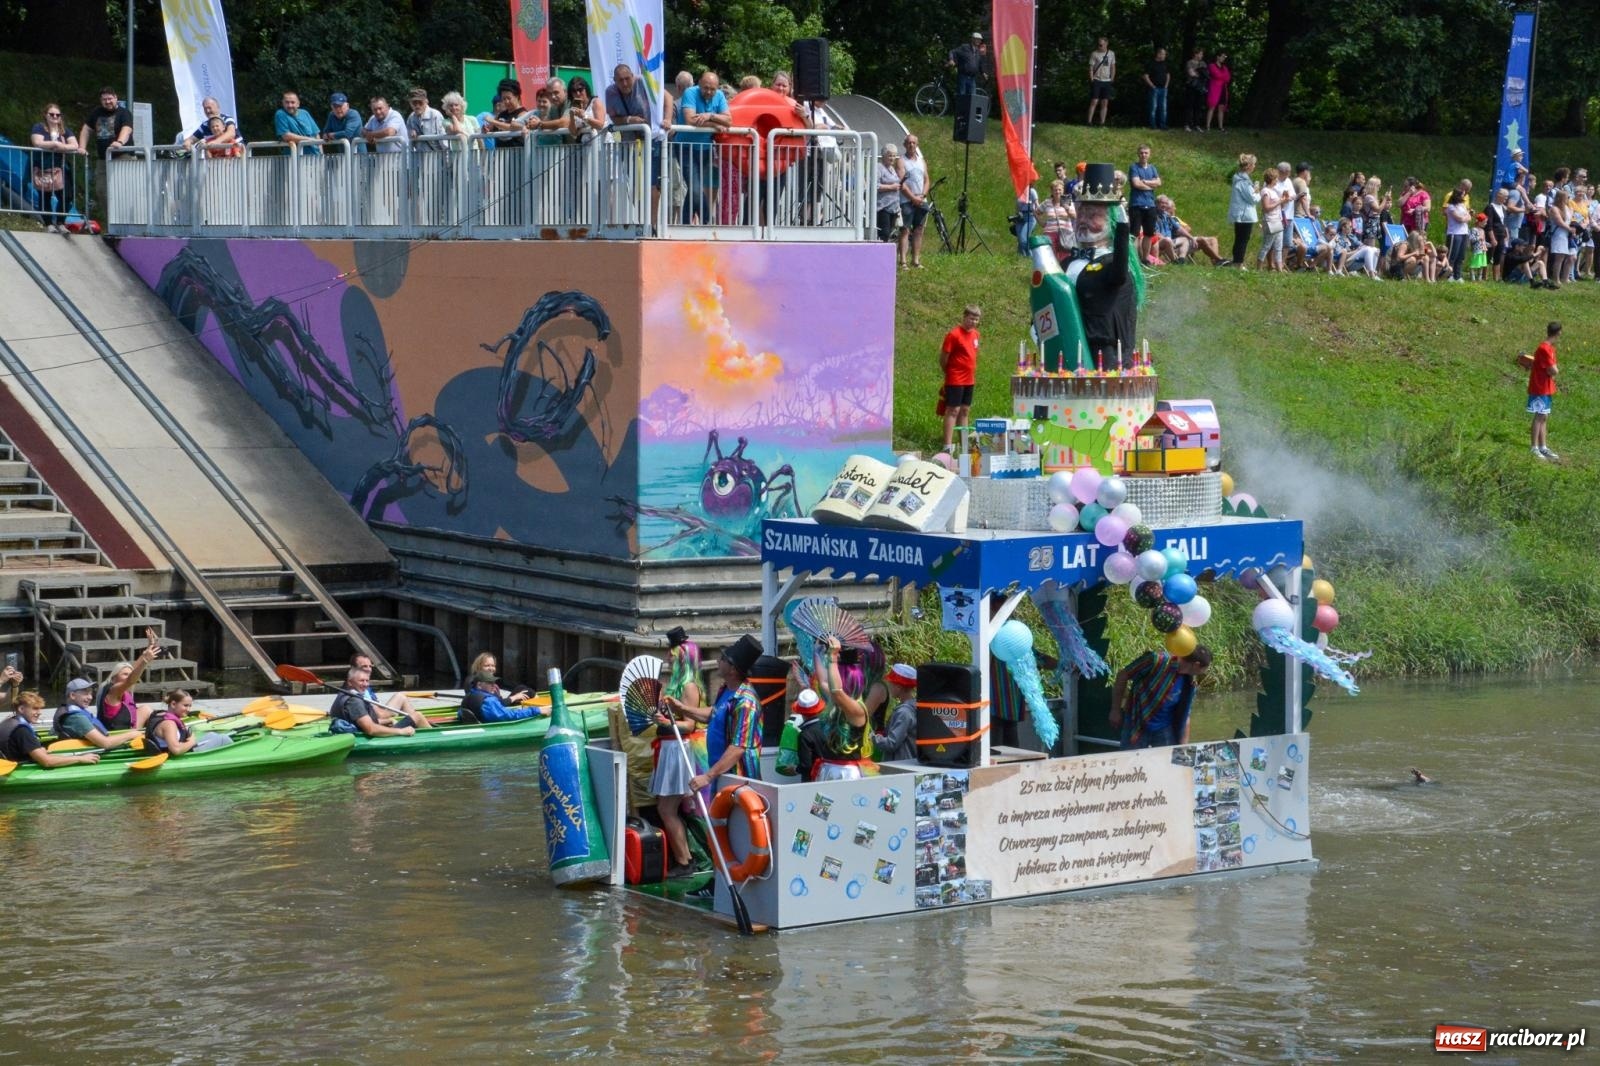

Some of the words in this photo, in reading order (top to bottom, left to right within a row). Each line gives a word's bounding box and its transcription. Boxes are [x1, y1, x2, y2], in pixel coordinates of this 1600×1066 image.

[1039, 311, 1052, 333] 25
[835, 463, 877, 487] istoria
[764, 528, 859, 559] SZAMPAŃSKA
[868, 537, 924, 566] ZAŁOGA
[1028, 545, 1054, 571] 25
[1062, 543, 1100, 569] LAT
[968, 610, 975, 626] 6
[932, 706, 959, 717] 1000
[1019, 780, 1035, 795] 25
[1035, 781, 1052, 793] raz
[1054, 774, 1075, 791] dziś
[1073, 771, 1102, 794] płyną
[1102, 766, 1148, 791] pływadła,
[998, 812, 1008, 825] ta
[1010, 809, 1050, 828] impreza
[1052, 800, 1105, 822] niejednemu
[1105, 798, 1131, 813] serce
[1131, 790, 1168, 810] skradła.
[999, 833, 1058, 853] Otworzymy
[1058, 828, 1110, 846] szampana,
[1112, 821, 1168, 840] zabalujemy,
[1013, 858, 1057, 883] jubileusz
[1059, 855, 1070, 871] do
[1072, 857, 1095, 869] rana
[1096, 845, 1154, 868] świętujemy!
